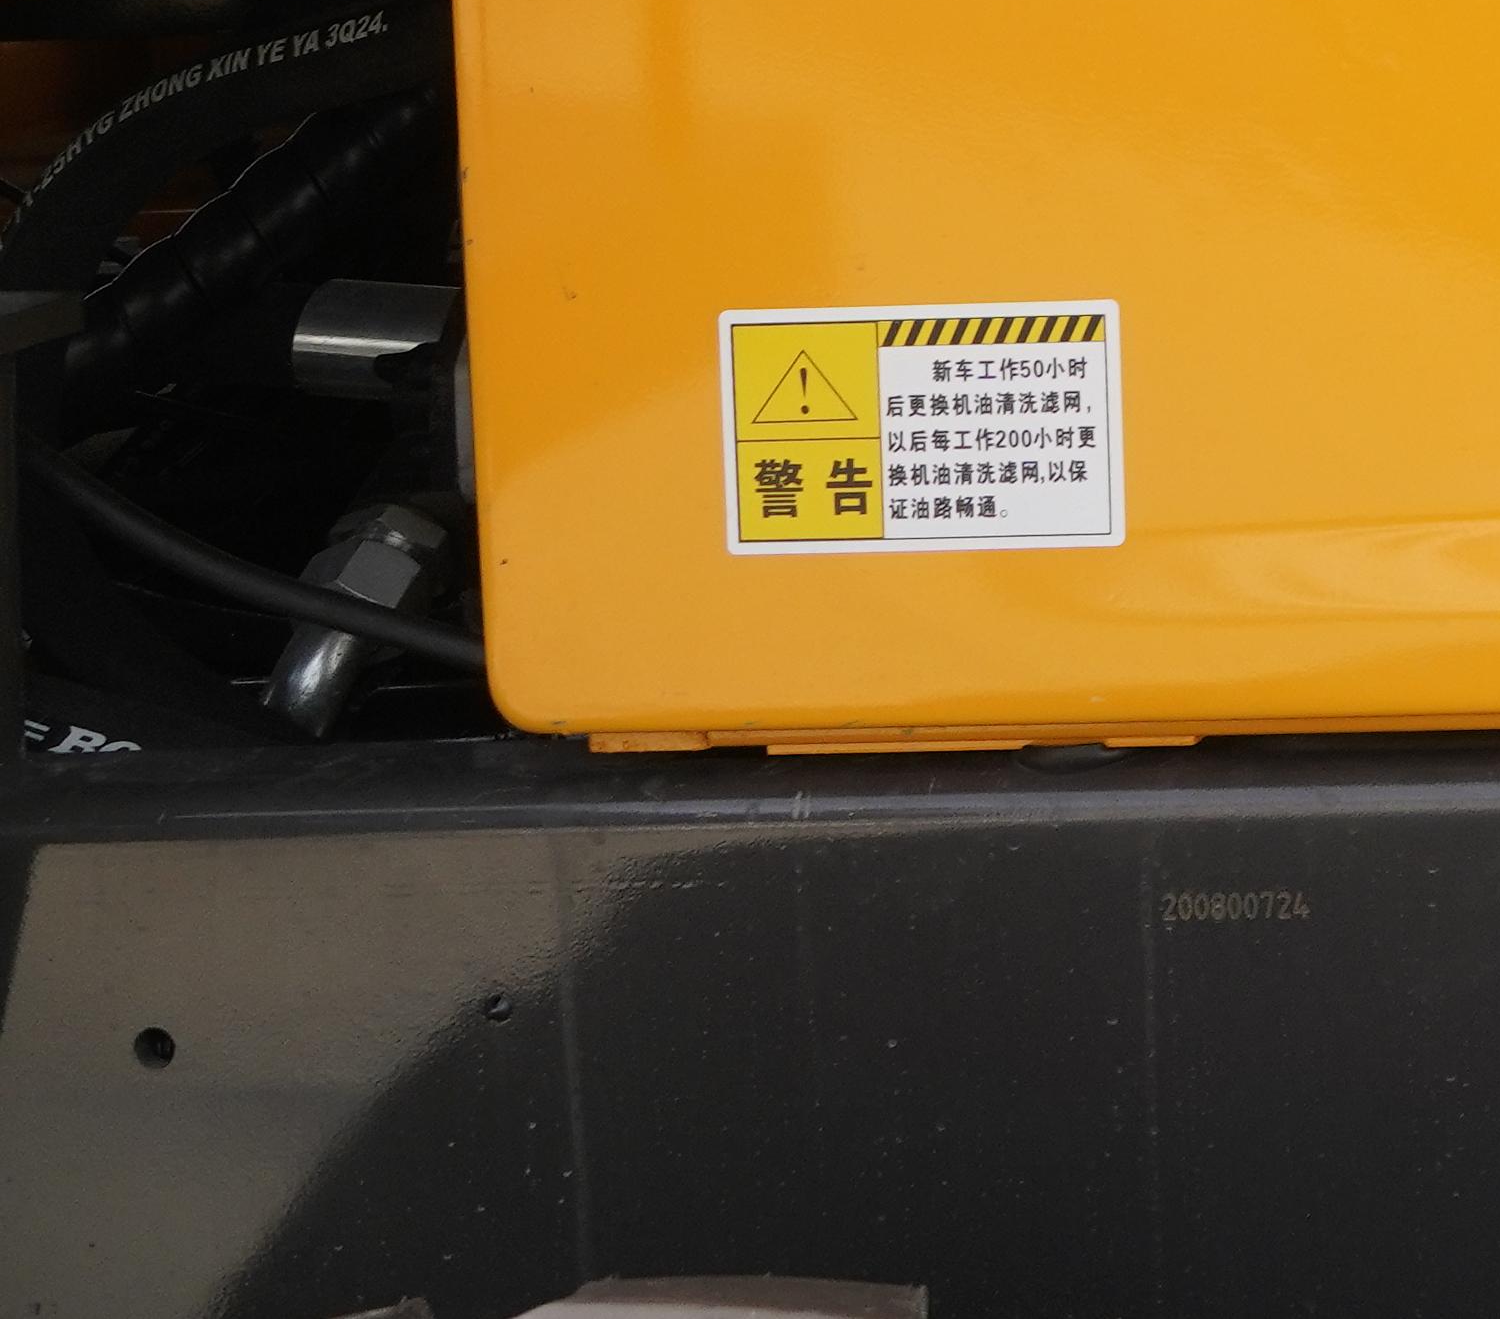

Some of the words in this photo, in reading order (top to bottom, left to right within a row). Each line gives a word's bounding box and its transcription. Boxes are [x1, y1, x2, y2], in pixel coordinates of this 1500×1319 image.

[118, 63, 204, 124] ZHONG
[205, 47, 252, 83] XIN
[255, 37, 289, 68] YE
[292, 28, 321, 59] YA
[931, 356, 1089, 383] 新车工作50小时
[888, 425, 1097, 453] 以后每工作200小时更
[754, 457, 874, 519] 警告
[888, 494, 1010, 521] 证油路畅通。
